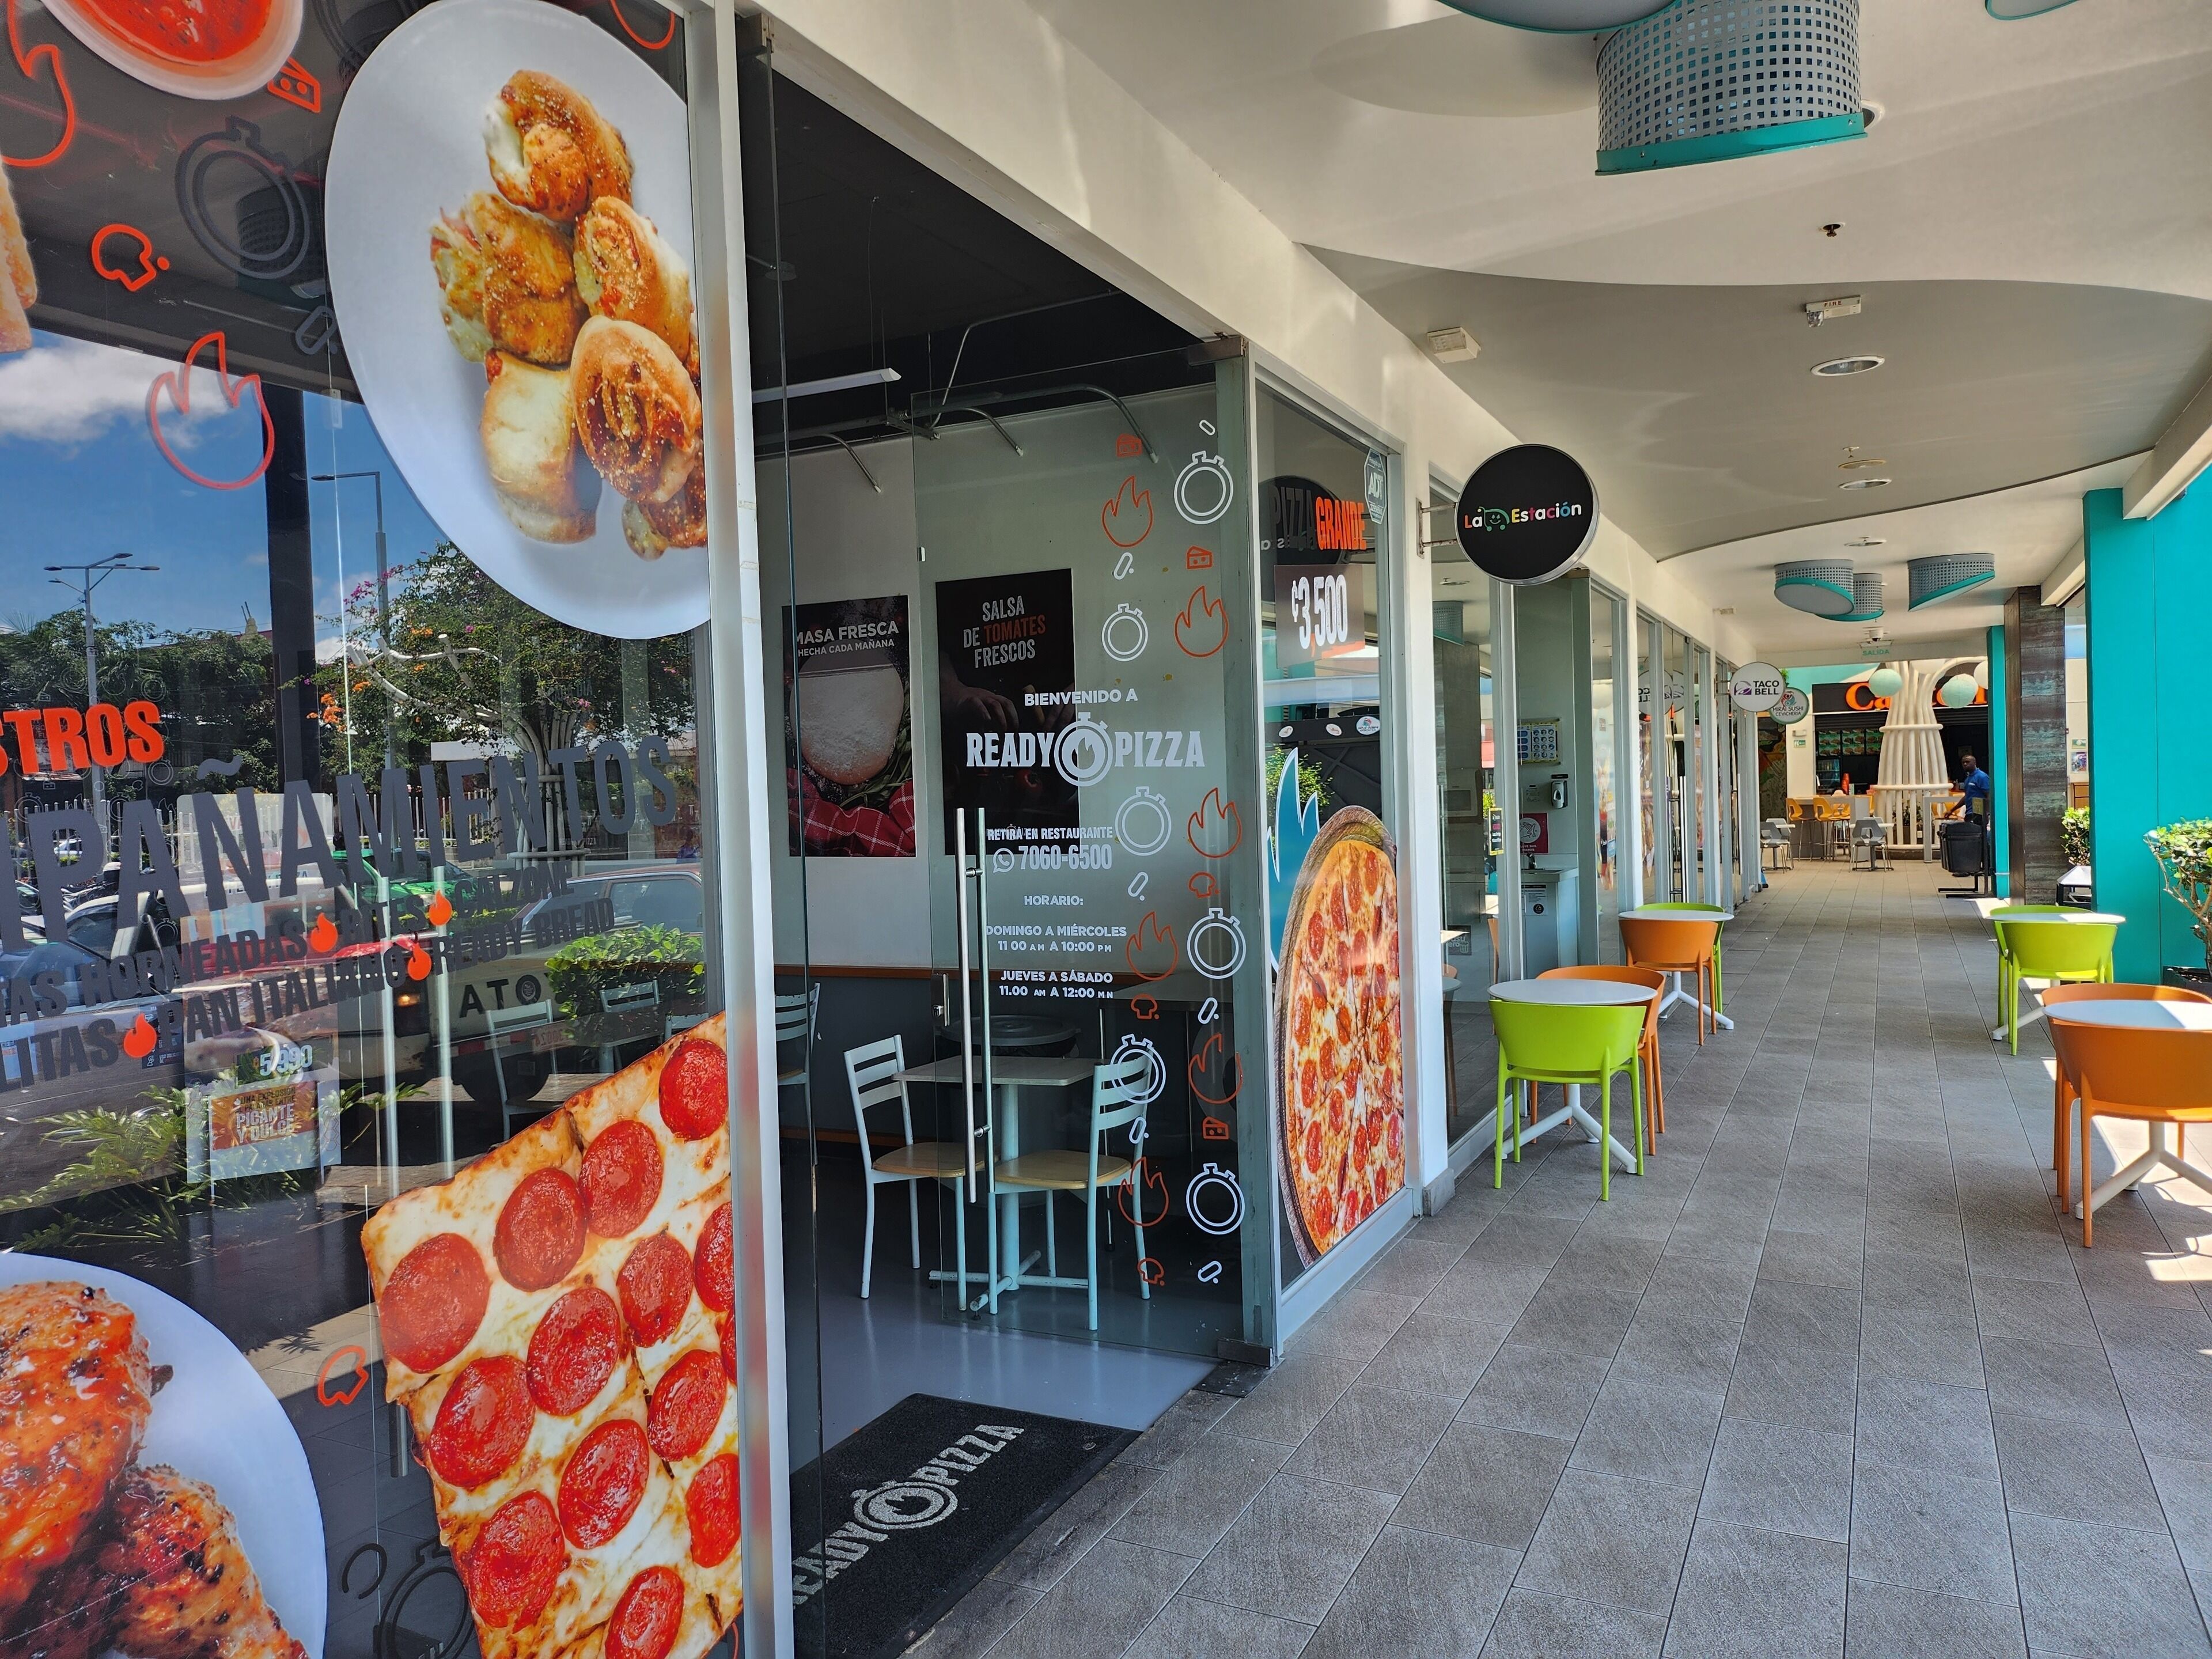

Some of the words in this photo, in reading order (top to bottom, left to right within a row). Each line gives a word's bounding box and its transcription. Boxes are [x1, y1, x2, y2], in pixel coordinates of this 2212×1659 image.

[1368, 471, 1384, 500] ADT
[1268, 485, 1316, 550] PIZZA
[1316, 497, 1366, 550] GRANDE
[1464, 514, 1483, 529] La
[1511, 502, 1582, 524] Estación
[982, 595, 1025, 622] SALSA
[796, 626, 834, 645] MASA
[838, 620, 899, 641] FRESCA
[963, 627, 980, 649] DE
[983, 614, 1046, 645] TOMATES
[798, 646, 827, 657] HECHA
[829, 642, 853, 653] CADA
[855, 638, 895, 651] MAÑANA
[974, 638, 1036, 669] FRESCOS
[1024, 690, 1122, 706] BIENVENIDO
[1126, 688, 1138, 702] A
[0, 700, 165, 777] TROS
[966, 732, 1055, 768] READY
[1114, 730, 1205, 768] PIZZA
[0, 736, 677, 953] PAÑAMIENTOS
[1025, 828, 1039, 840] EN
[1041, 826, 1113, 839] RESTAURANTE
[1018, 844, 1113, 870] 7060-6500
[1024, 895, 1084, 906] HORARIO:
[80, 918, 308, 1007] HORNEADAS
[455, 859, 574, 918] CALZONE
[1045, 926, 1054, 936] A
[1057, 923, 1127, 937] MIÉRCOLES
[1050, 941, 1059, 951] A
[1061, 941, 1094, 952] 10:00
[157, 986, 243, 1046] PAN
[250, 946, 406, 1027] ITALIANO
[433, 922, 524, 976] READY
[533, 897, 615, 950] BREAD
[1001, 970, 1046, 982] JUEVES
[1048, 971, 1058, 982] A
[1060, 969, 1113, 983] SÁBADO
[1050, 987, 1059, 997] A
[1062, 987, 1094, 998] 12:00
[237, 1103, 295, 1128] PICANTE
[251, 1118, 295, 1141] DULCE
[792, 1521, 889, 1608] EADY
[910, 1423, 1025, 1486] PIZZA
